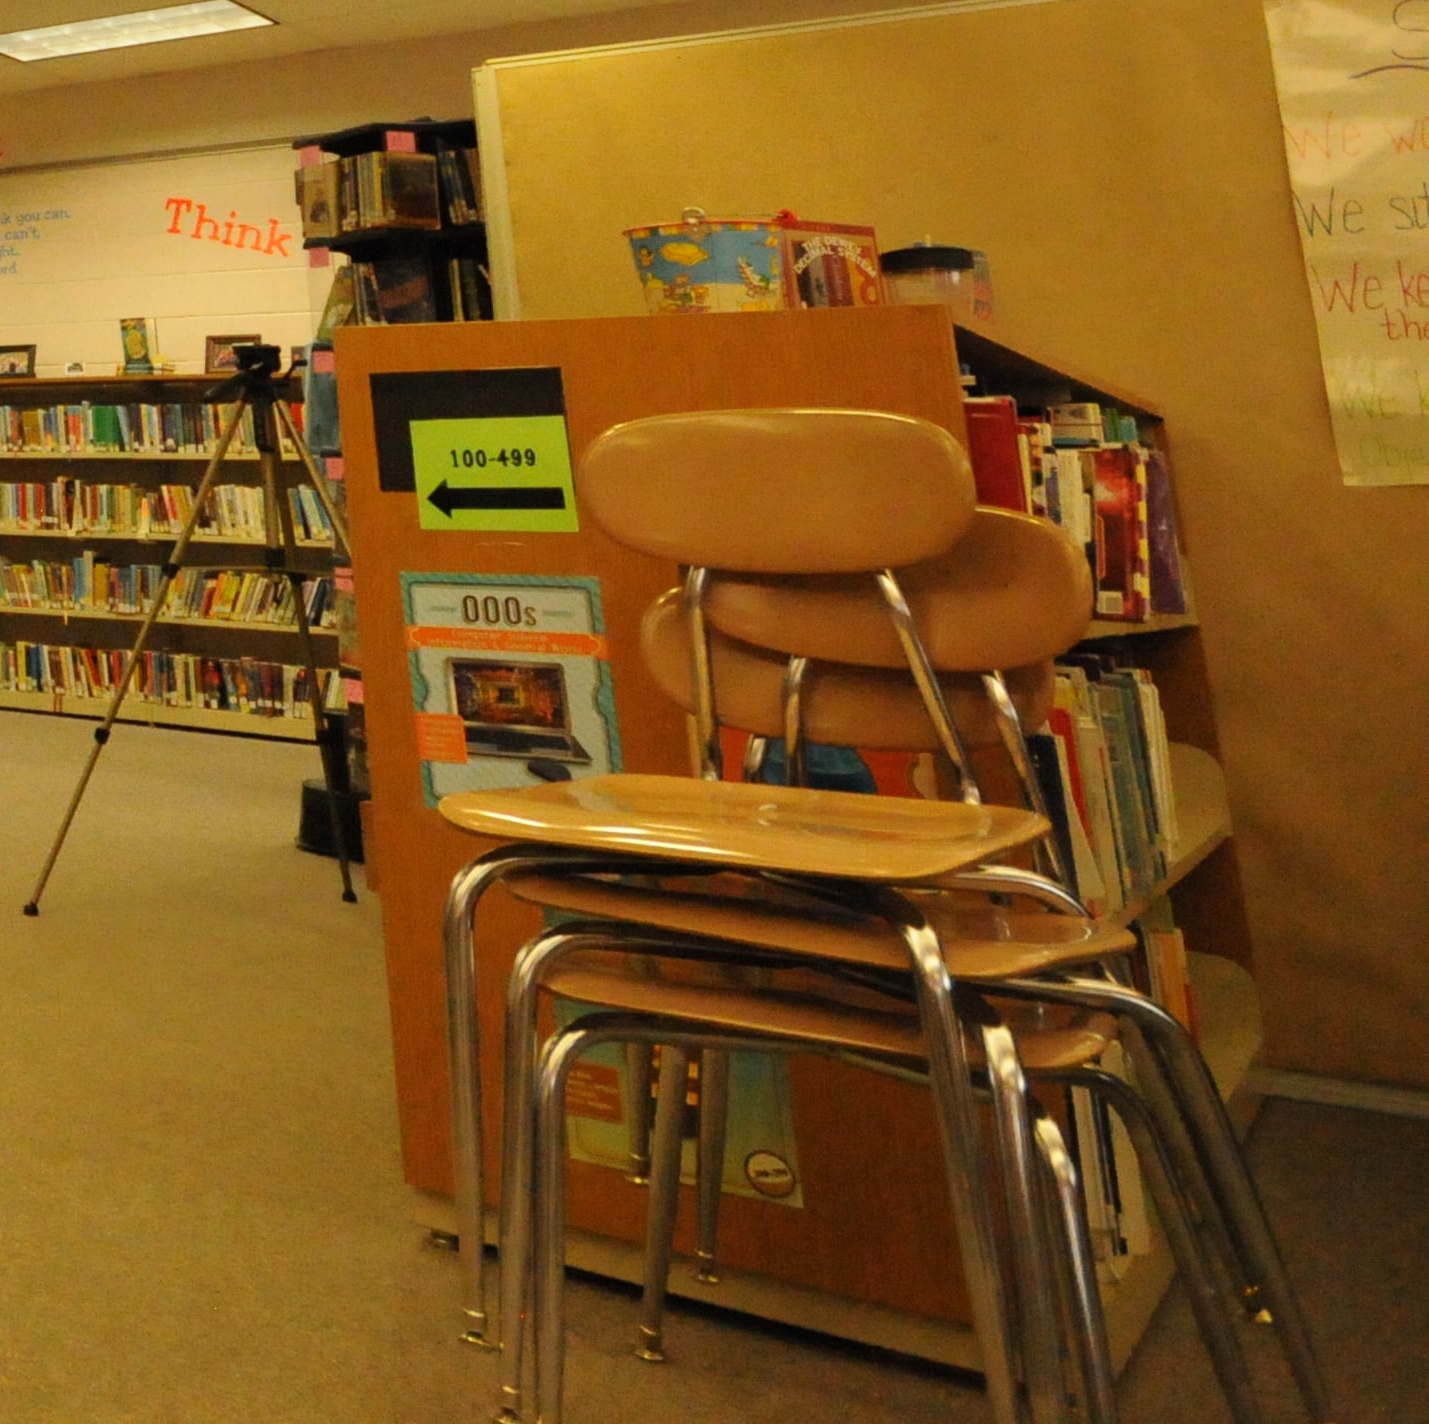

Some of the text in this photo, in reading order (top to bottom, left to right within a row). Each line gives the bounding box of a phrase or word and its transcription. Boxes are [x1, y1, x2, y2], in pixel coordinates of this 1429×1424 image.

[16, 211, 41, 226] you
[165, 197, 293, 257] Think
[1291, 185, 1365, 236] We
[1310, 261, 1385, 313] We
[450, 448, 537, 469] 100-499
[462, 594, 537, 626] 000s
